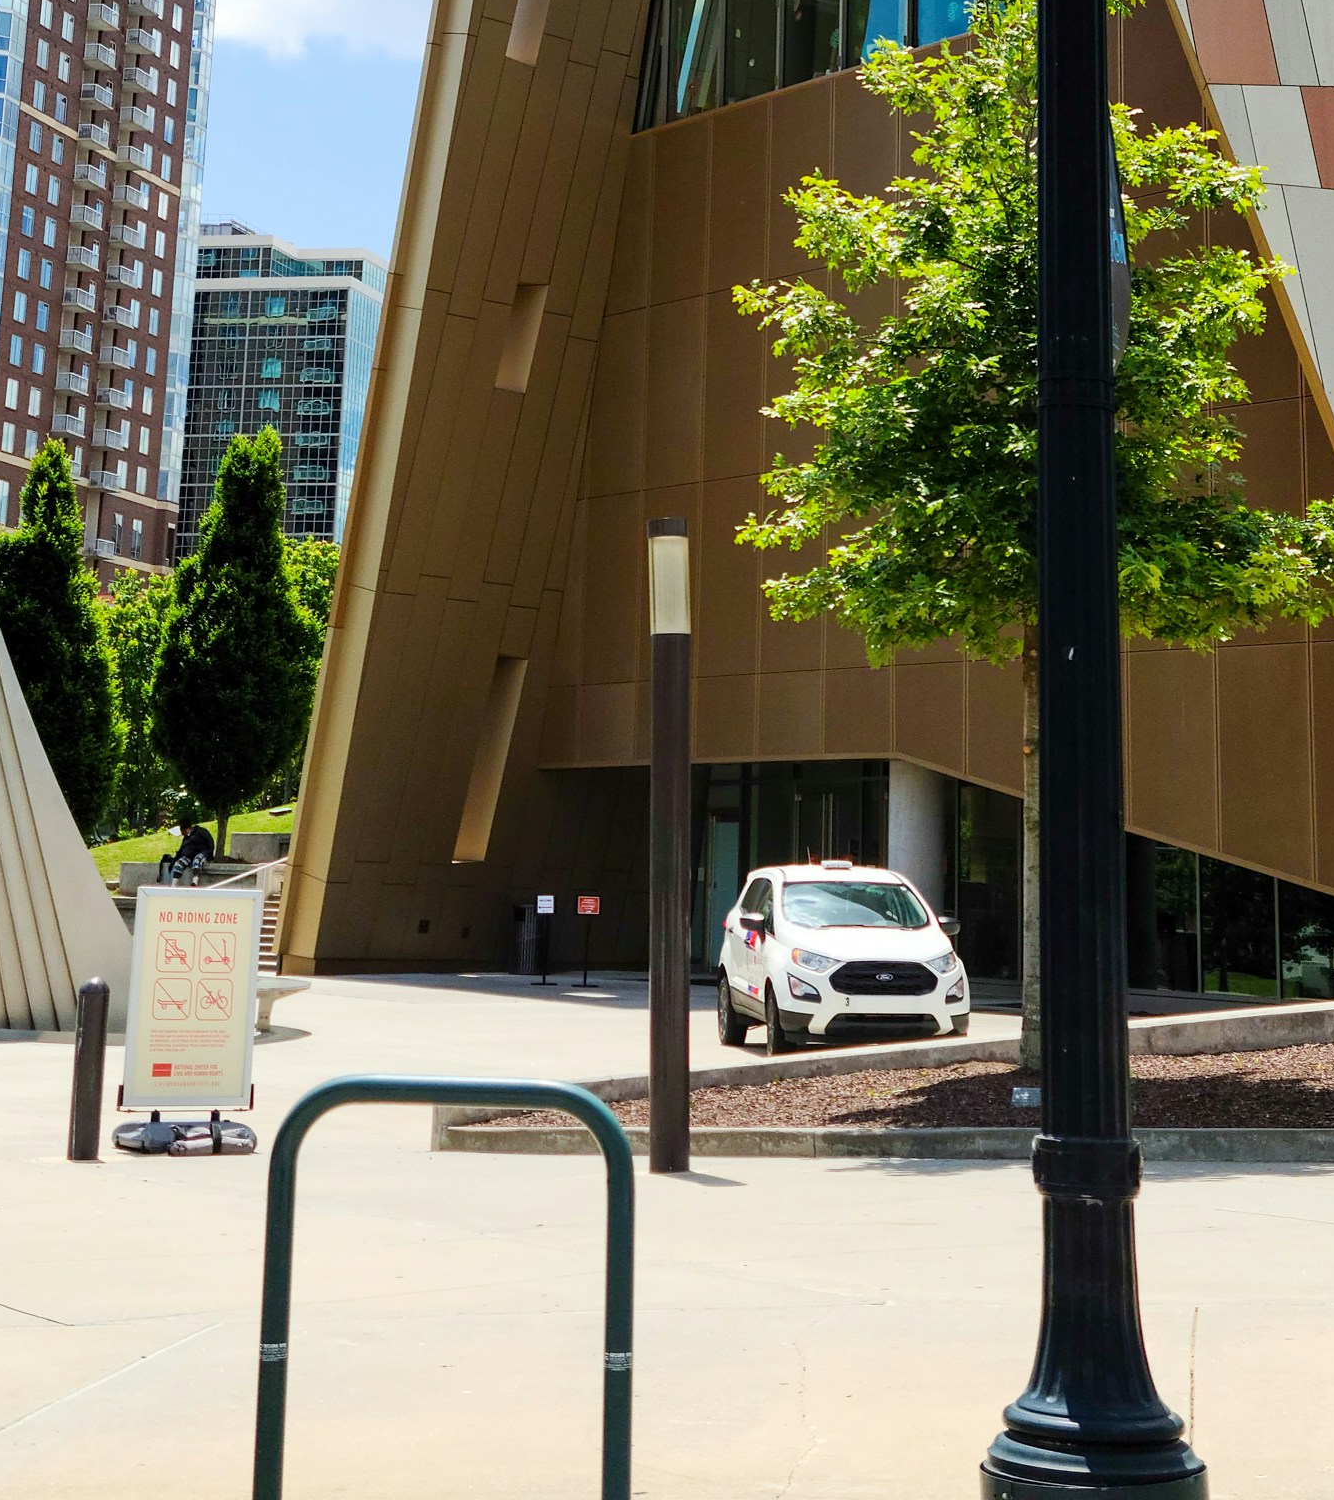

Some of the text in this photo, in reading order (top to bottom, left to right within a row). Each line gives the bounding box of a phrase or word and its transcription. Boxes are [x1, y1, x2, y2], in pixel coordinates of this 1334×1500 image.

[159, 911, 238, 925] NO RIDING ZONE
[845, 997, 850, 1007] 3
